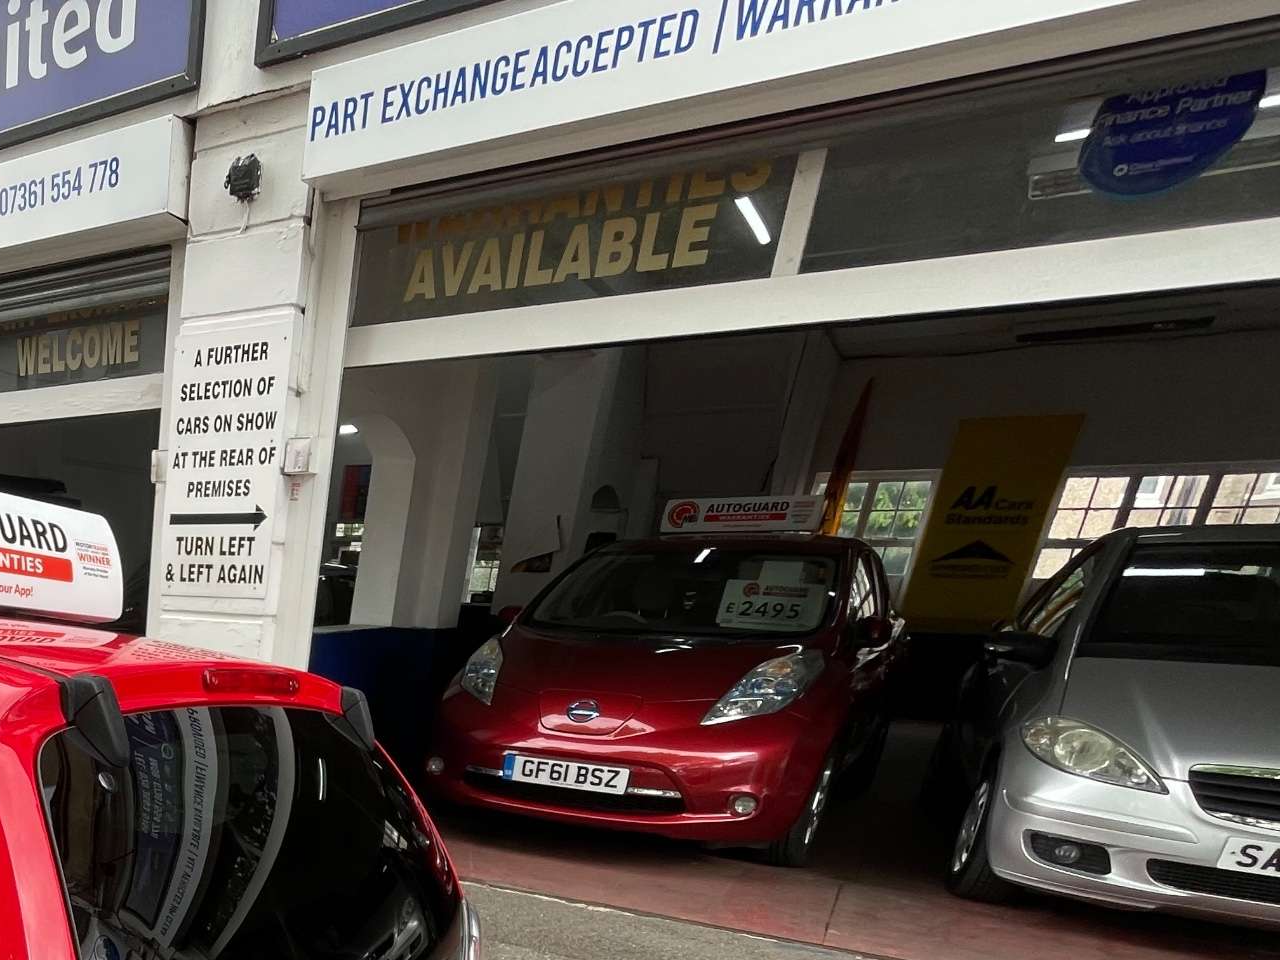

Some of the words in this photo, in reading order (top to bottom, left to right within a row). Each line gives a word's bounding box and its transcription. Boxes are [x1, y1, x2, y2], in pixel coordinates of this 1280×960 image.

[1176, 89, 1256, 114] Partner
[310, 91, 374, 142] PART
[0, 179, 46, 216] 07361
[51, 167, 82, 203] 554
[89, 157, 120, 194] 778
[404, 203, 719, 303] AVAILABLE
[16, 319, 142, 378] WELCOME
[194, 349, 203, 368] A
[207, 341, 269, 366] FURTHER
[180, 378, 253, 402] SELECTION
[257, 376, 275, 396] OF
[176, 417, 210, 435] CARS
[214, 414, 232, 433] ON
[236, 411, 277, 432] SHOW
[172, 451, 188, 470] AT
[192, 450, 216, 468] THE
[219, 448, 254, 467] REAR
[258, 446, 277, 465] OF
[187, 479, 251, 498] PREMISES
[950, 485, 998, 511] AA
[995, 499, 1034, 511] Cars
[706, 501, 791, 514] AUTOGUARD
[944, 512, 1029, 526] Standards
[176, 536, 216, 556] TURN
[219, 536, 256, 556] LEFT
[77, 552, 112, 566] WINNER
[165, 563, 175, 582] &
[179, 564, 215, 583] LEFT
[217, 564, 264, 585] AGAIN
[14, 585, 34, 598] App!
[739, 600, 802, 619] 2495
[522, 760, 569, 782] GF61
[574, 766, 622, 789] BSZ
